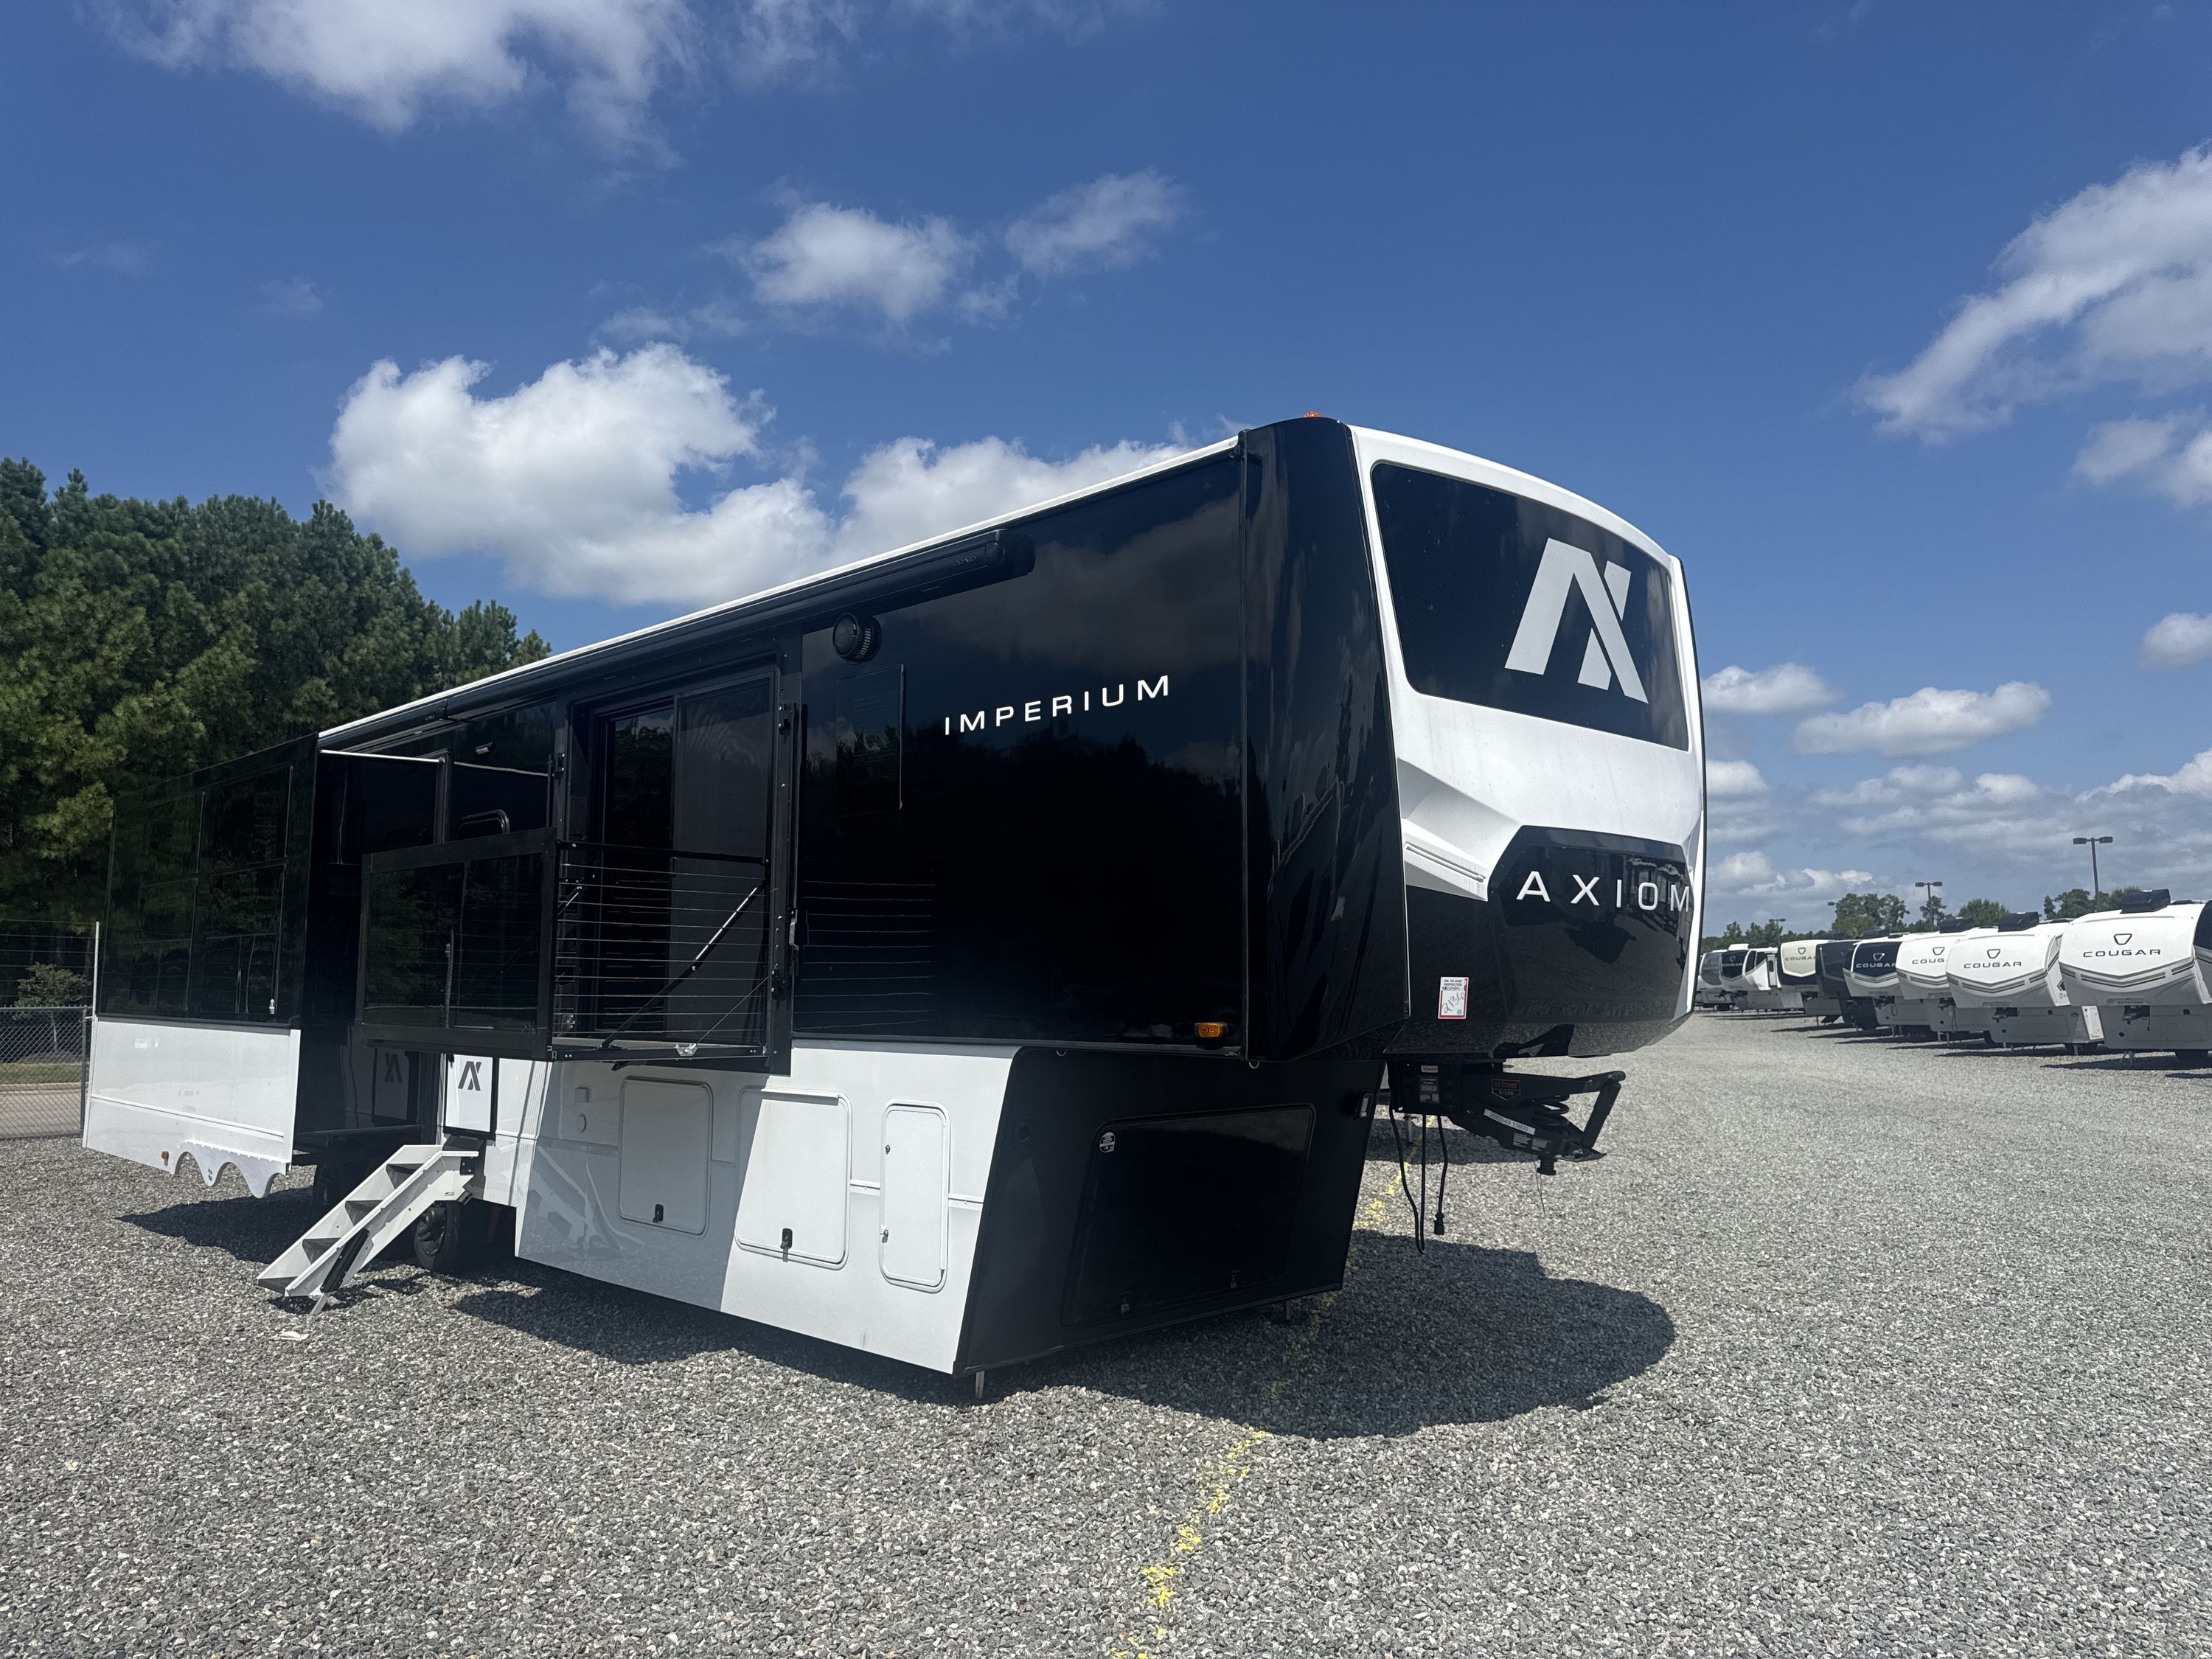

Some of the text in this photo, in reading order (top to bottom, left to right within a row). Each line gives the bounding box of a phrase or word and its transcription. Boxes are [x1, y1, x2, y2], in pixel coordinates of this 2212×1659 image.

[944, 675, 1169, 736] IMPERIUM
[1515, 870, 1691, 913] AXIOM
[2083, 949, 2161, 958] COUGAR
